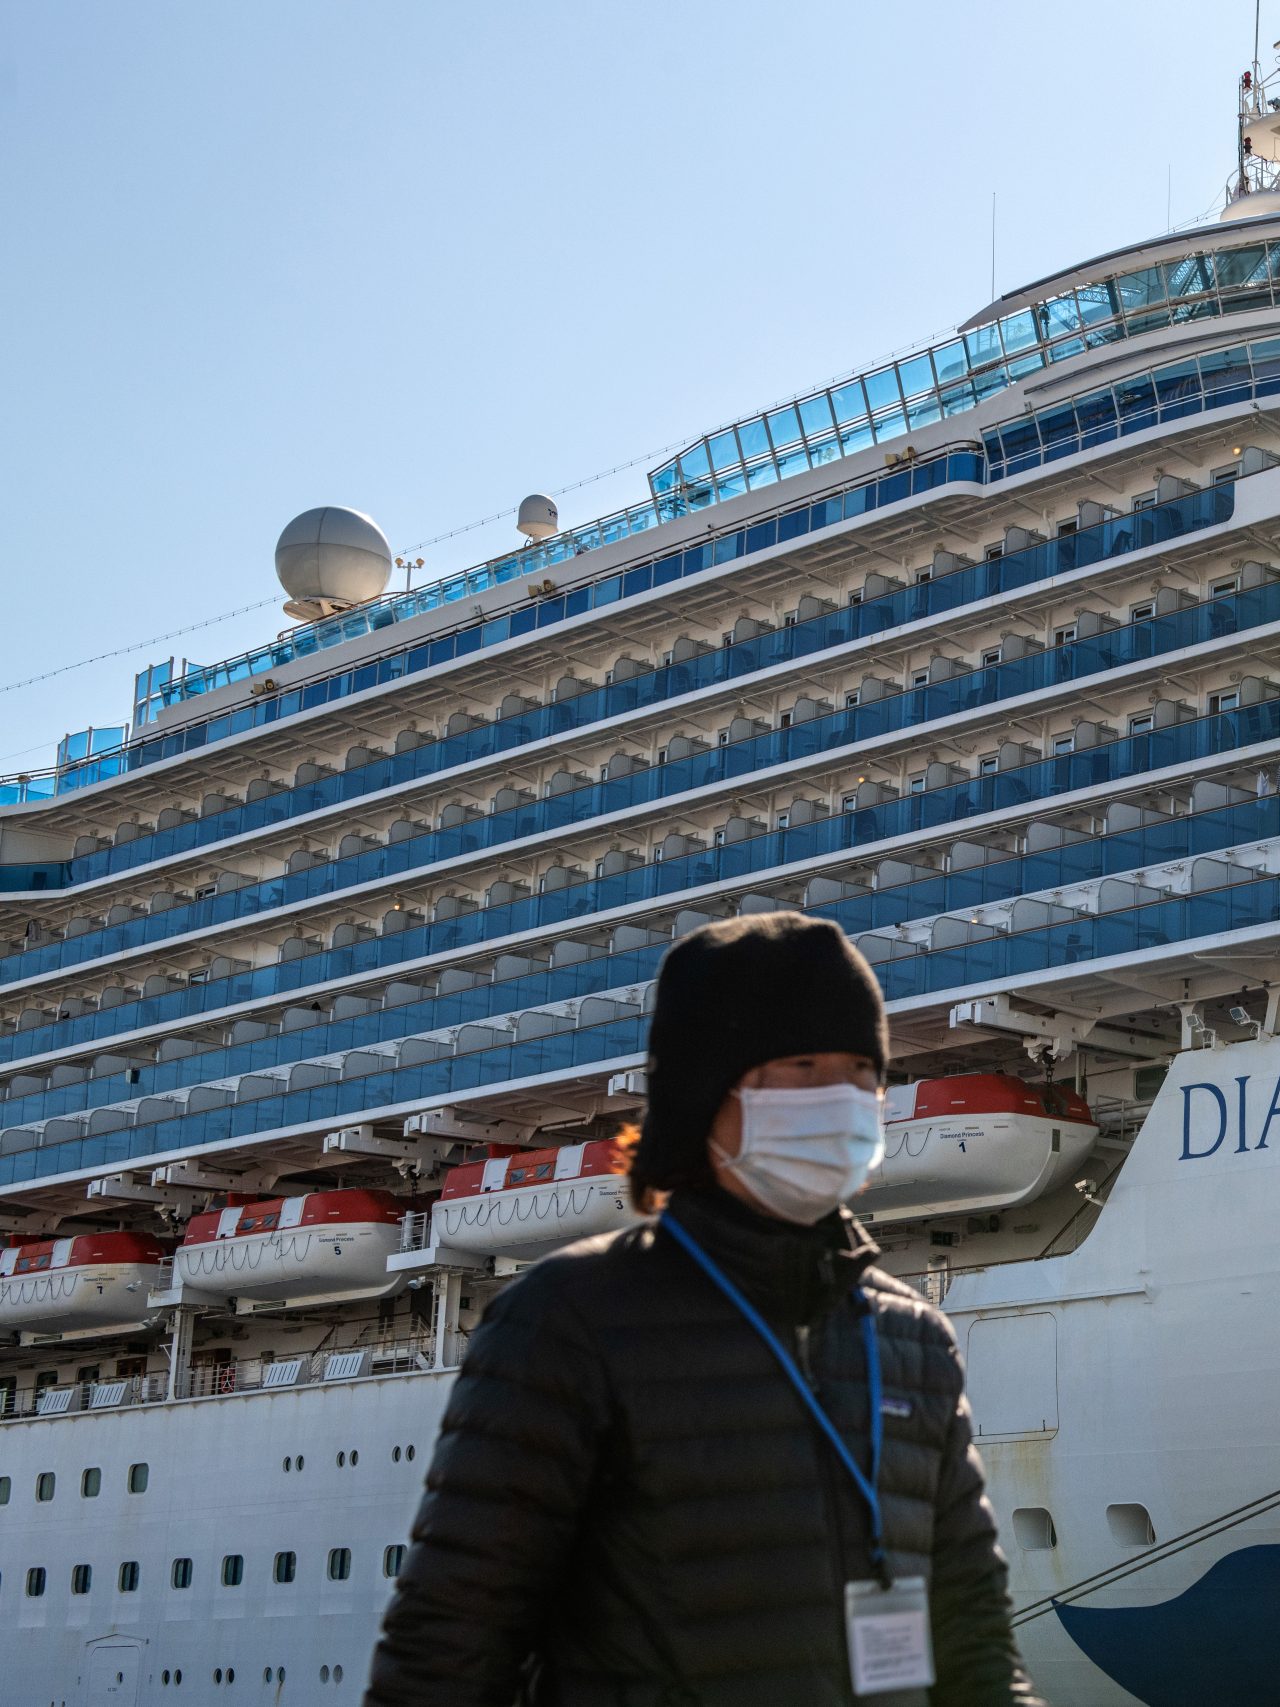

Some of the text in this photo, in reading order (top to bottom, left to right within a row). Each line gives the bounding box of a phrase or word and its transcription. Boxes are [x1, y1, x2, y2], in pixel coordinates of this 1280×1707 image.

[958, 1142, 967, 1153] 1
[615, 1199, 624, 1210] 3
[334, 1245, 342, 1256] 5
[97, 1286, 103, 1295] 7
